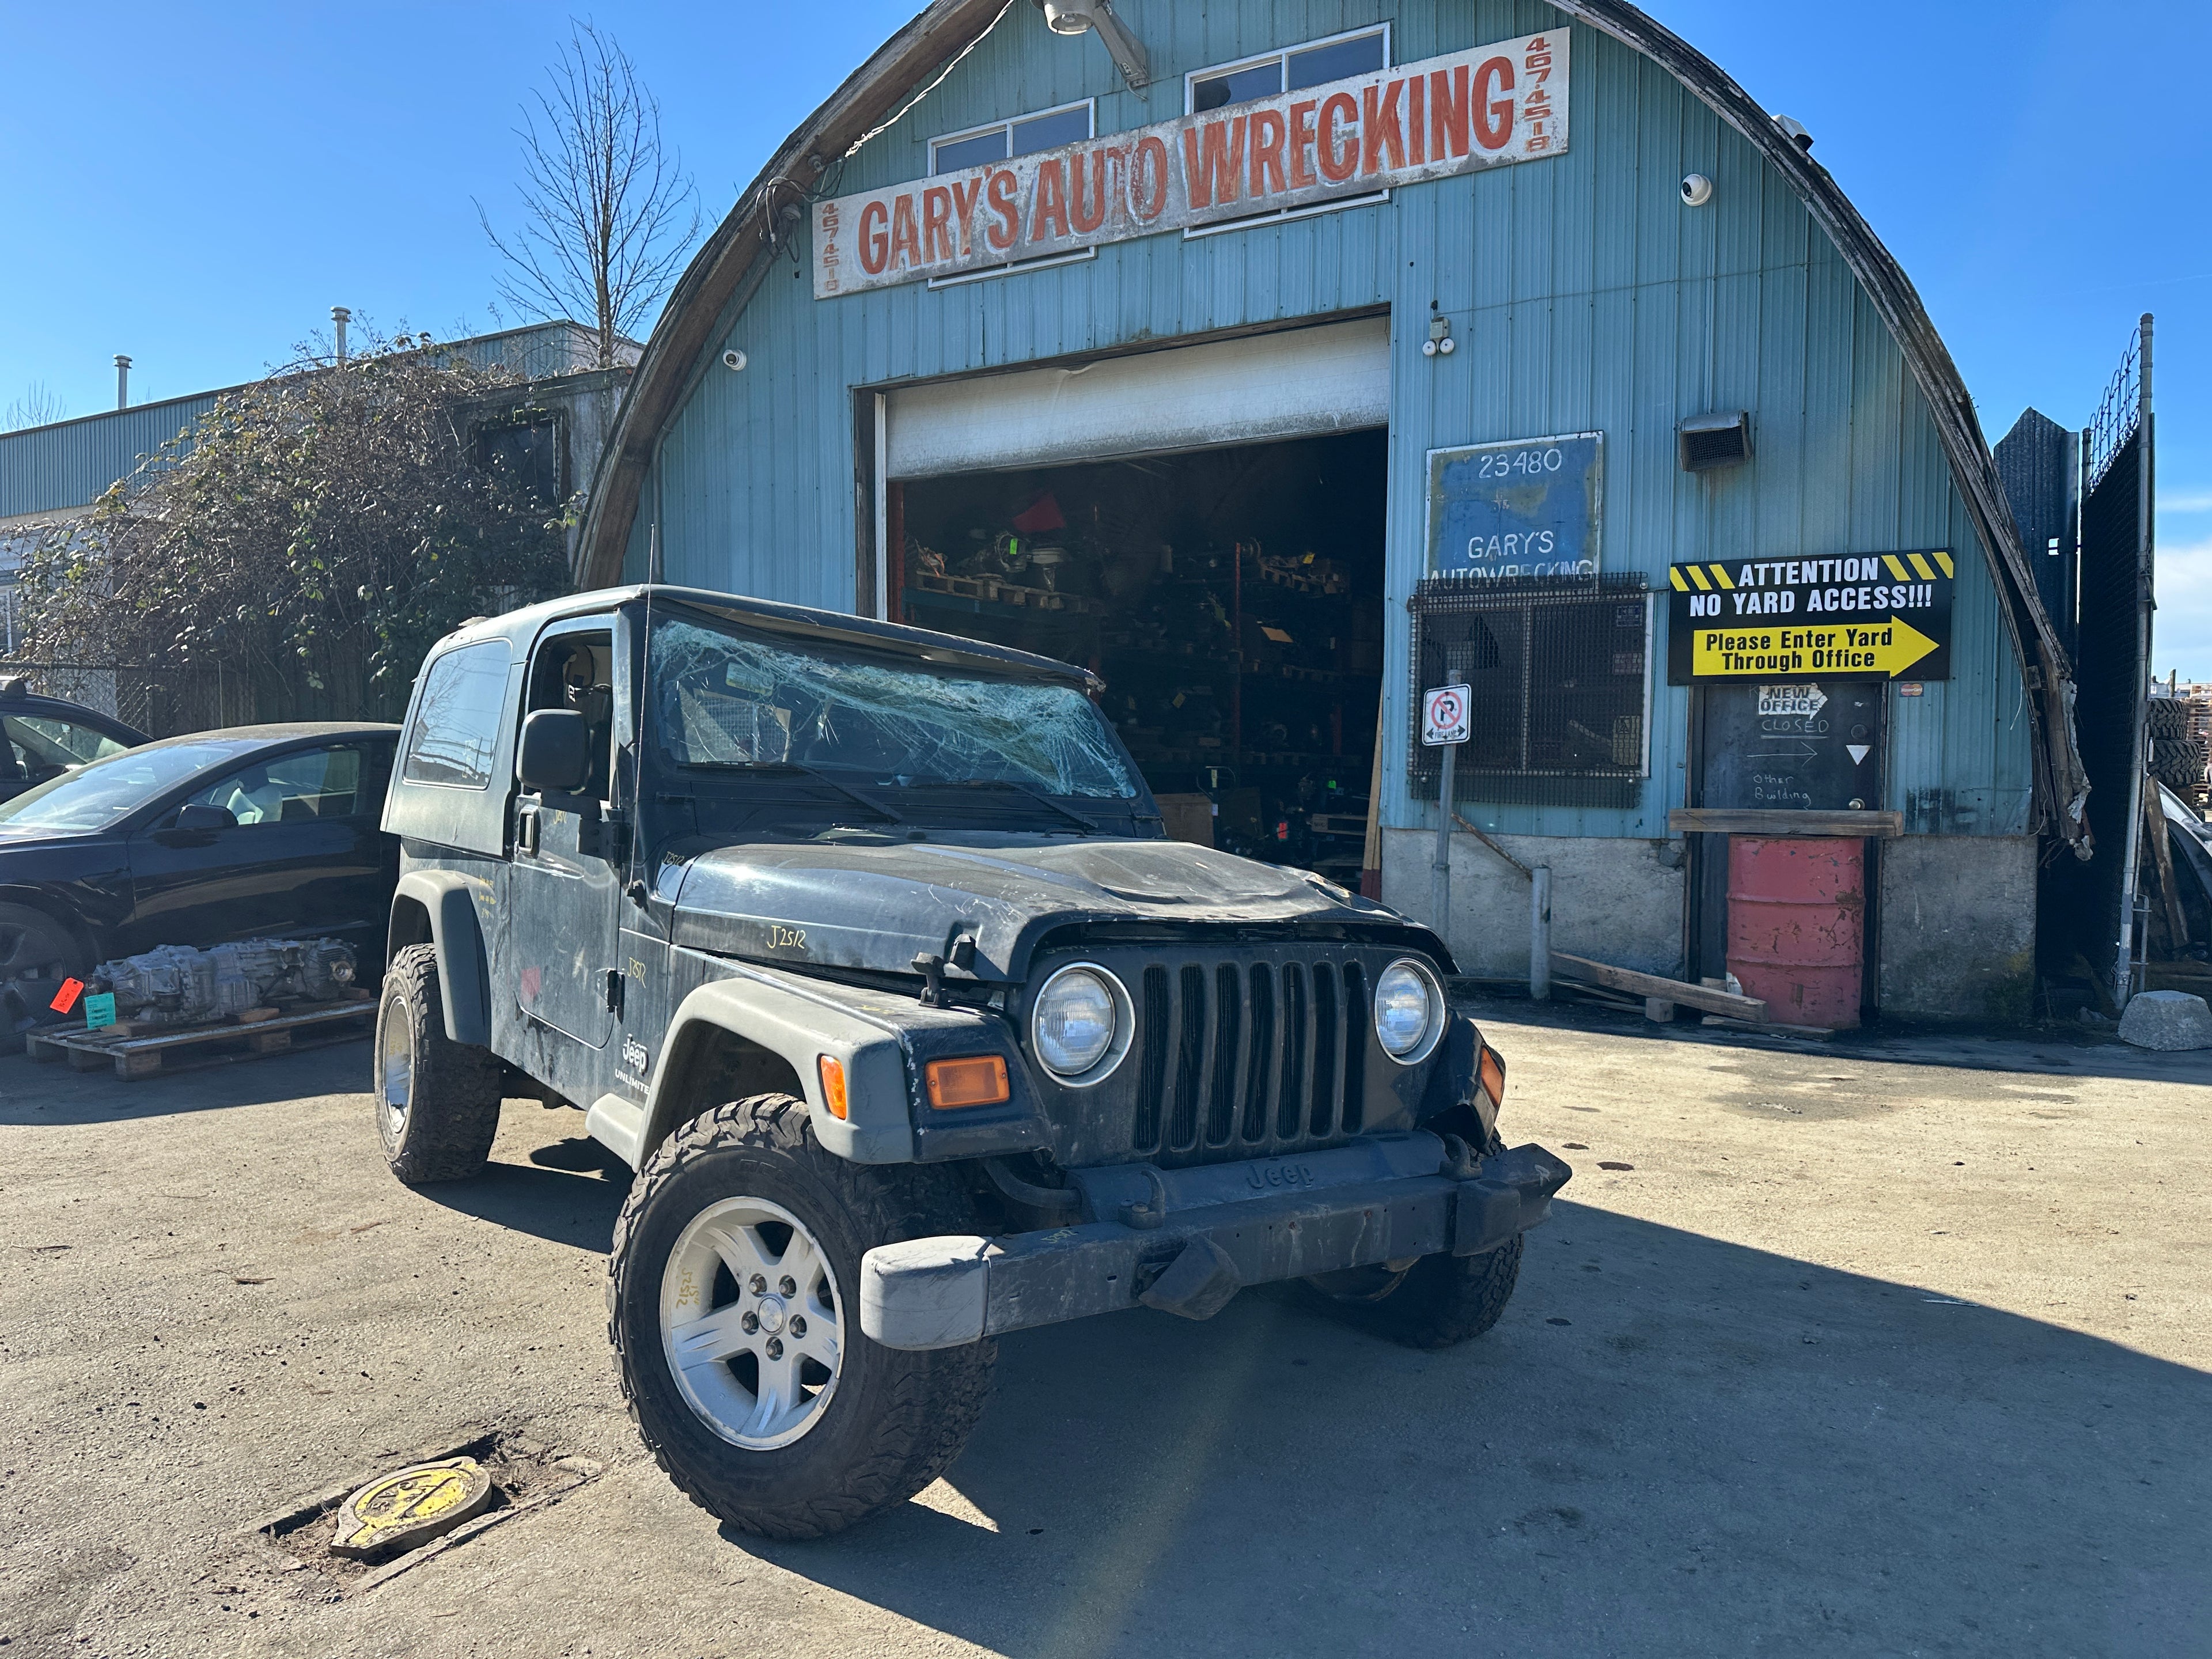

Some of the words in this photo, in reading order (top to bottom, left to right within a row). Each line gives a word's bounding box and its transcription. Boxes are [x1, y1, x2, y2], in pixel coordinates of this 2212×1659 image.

[858, 166, 1018, 274] GARY'S
[1031, 137, 1168, 242] AUTO
[1184, 56, 1515, 209] WRECKING
[1478, 448, 1562, 479] 23480
[1468, 530, 1554, 559] GARY'S
[1738, 557, 1878, 587] ATTENTION
[1690, 594, 1721, 617] NO
[1733, 590, 1796, 615] YARD
[1806, 584, 1932, 612] ACCESS!!!
[1706, 632, 1771, 652] Please
[1781, 631, 1836, 649] Enter
[1844, 627, 1892, 647] Yard
[1722, 652, 1802, 672] Through
[1812, 649, 1875, 668] Office
[1769, 685, 1810, 699] NEW
[1760, 699, 1819, 712] OFFICE
[1762, 718, 1830, 733] CLOSED
[1755, 787, 1812, 808] Building
[767, 925, 806, 949] J2512
[623, 1033, 648, 1073] Jeep
[615, 1068, 650, 1094] UNLIMITE
[1247, 1164, 1315, 1189] Jeep
